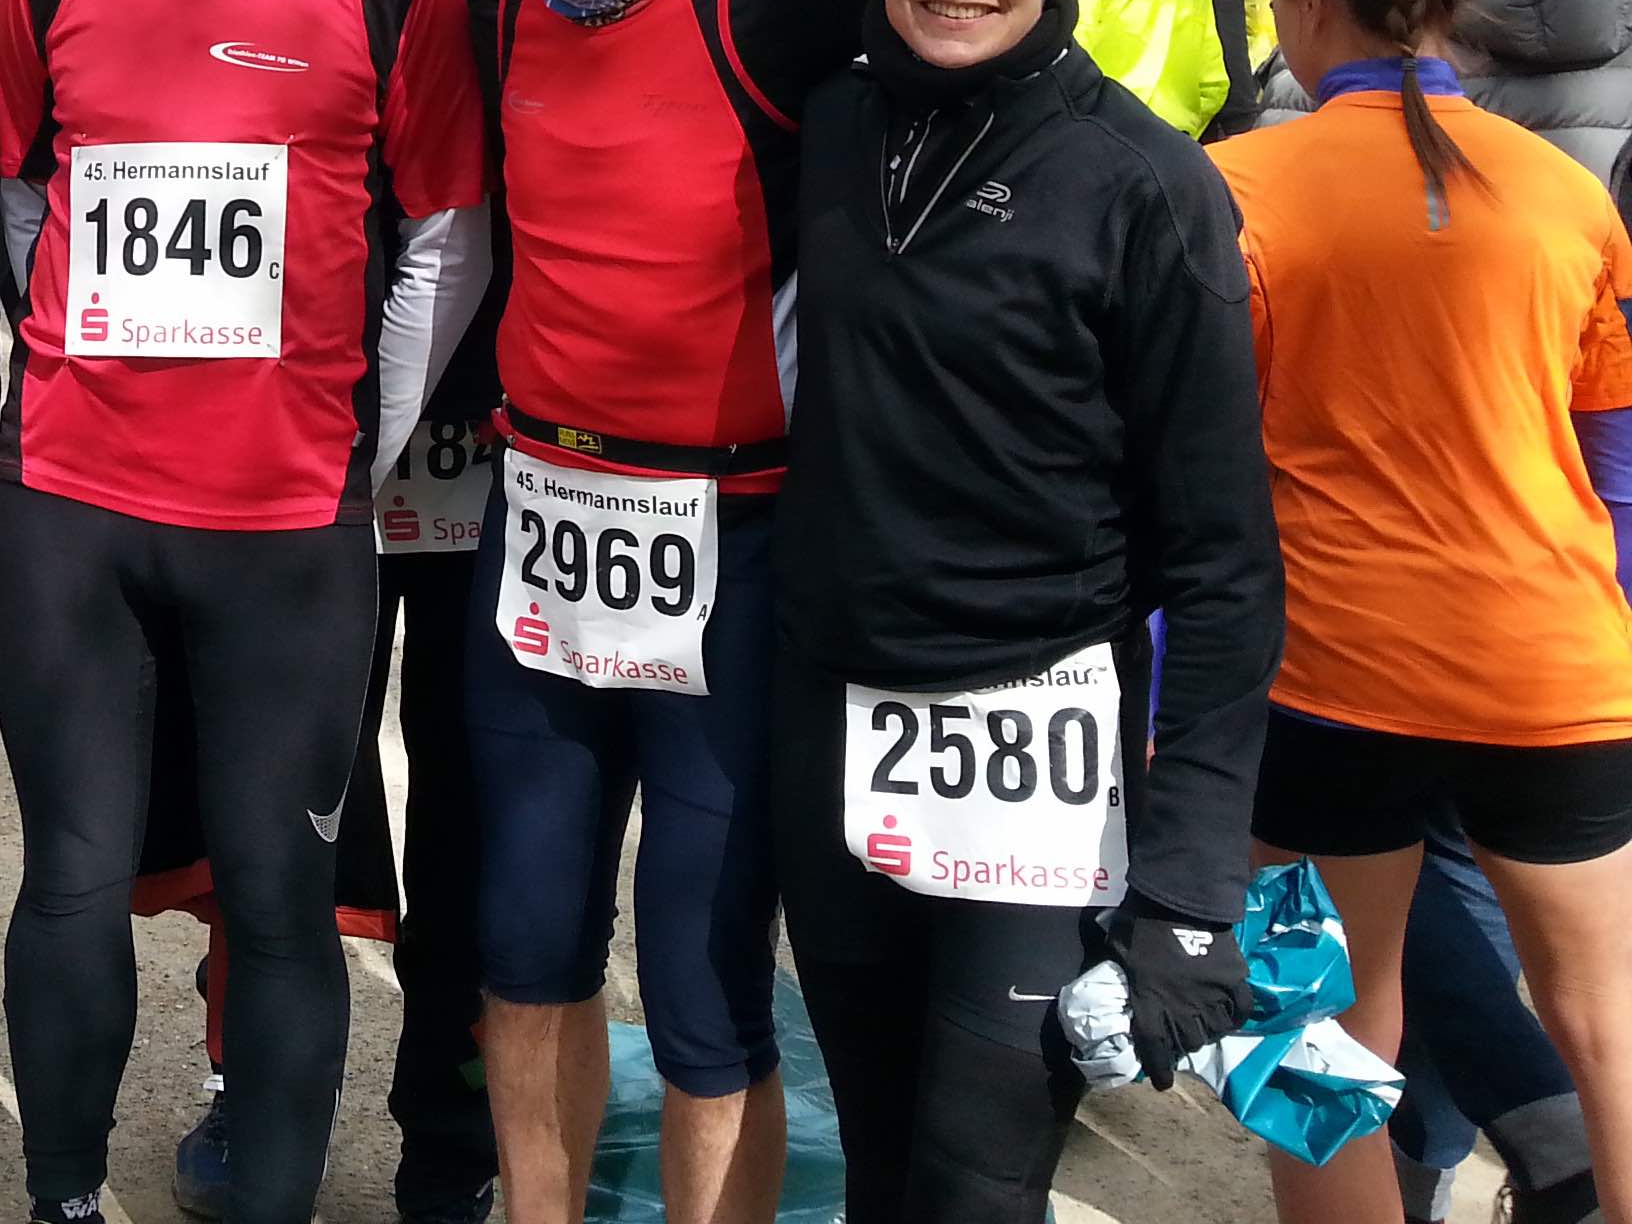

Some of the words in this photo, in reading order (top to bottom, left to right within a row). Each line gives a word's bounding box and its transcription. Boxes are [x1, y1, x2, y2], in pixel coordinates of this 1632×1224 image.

[83, 162, 107, 181] 45.
[113, 161, 270, 181] Hermannslauf
[85, 197, 263, 278] 1846
[121, 318, 262, 349] Sparkasse
[517, 470, 538, 494] 45.
[544, 477, 699, 518] Hermannslauf
[521, 508, 696, 617] 2969
[560, 640, 689, 684] Sparkasse
[870, 700, 1099, 805] 2580
[931, 850, 1109, 891] Sparkasse
